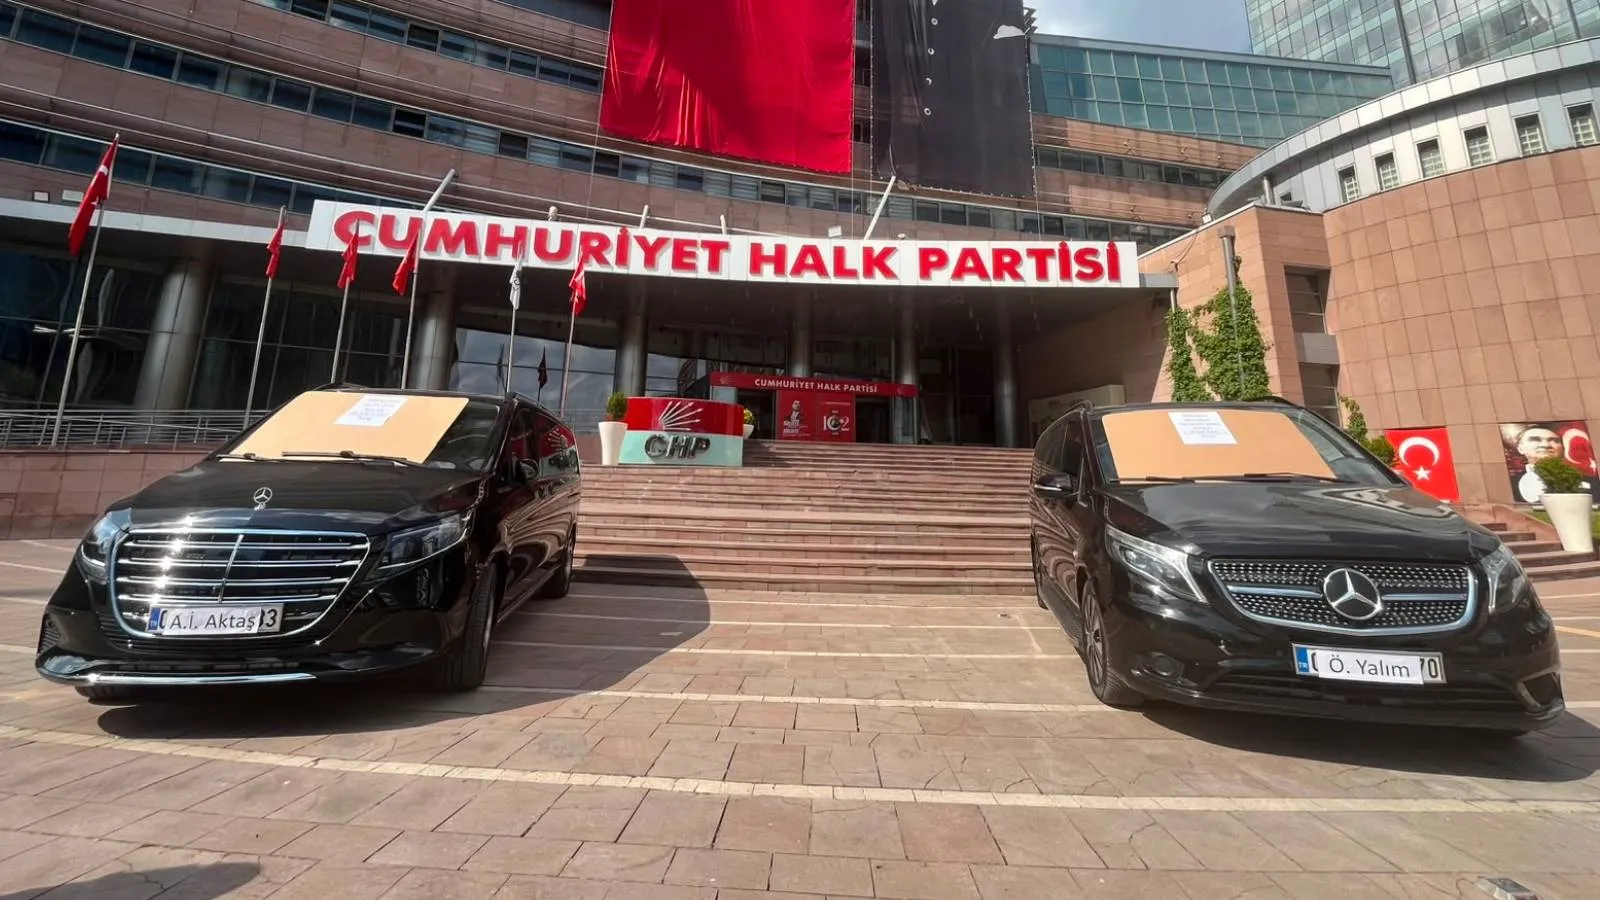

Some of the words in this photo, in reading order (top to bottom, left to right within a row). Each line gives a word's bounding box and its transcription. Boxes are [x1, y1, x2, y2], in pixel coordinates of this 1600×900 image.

[333, 210, 730, 274] CUMHURİYET
[750, 242, 898, 280] HALK
[918, 240, 1122, 283] PARTİSİ
[754, 378, 814, 390] CUMHURİYET
[817, 382, 841, 391] HALK
[843, 384, 878, 393] PARTİSİ
[645, 434, 711, 458] CHP
[204, 613, 256, 632] Aktaş
[1329, 654, 1351, 674] Ö.
[1356, 658, 1410, 678] Yalım
